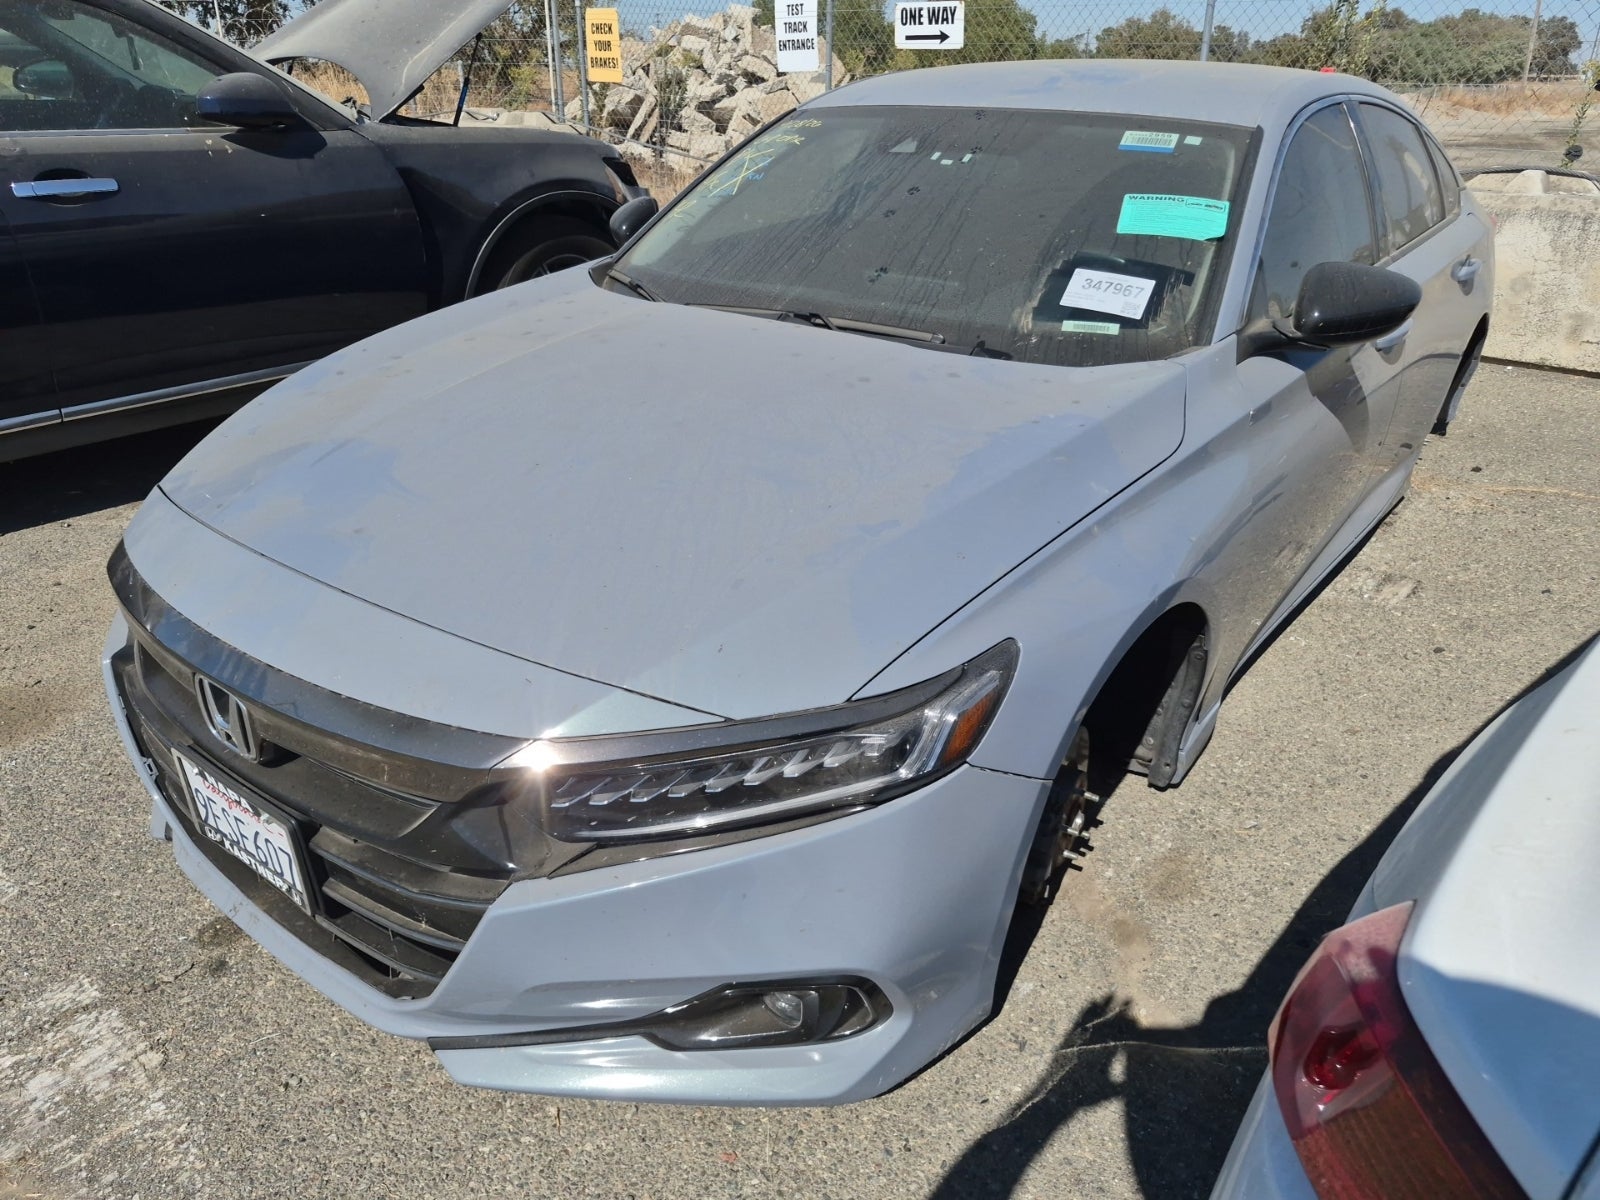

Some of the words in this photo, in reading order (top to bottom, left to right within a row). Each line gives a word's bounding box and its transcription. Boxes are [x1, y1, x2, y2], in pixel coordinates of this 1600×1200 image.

[786, 4, 804, 16] TEST
[900, 7, 924, 26] ONE
[927, 6, 957, 25] WAY
[590, 22, 613, 35] CHECK
[784, 21, 808, 34] TRACK
[593, 40, 612, 52] YOUR
[778, 38, 815, 52] ENTRANCE
[590, 57, 619, 69] BRAKES!
[1128, 195, 1185, 203] WARNING
[1081, 278, 1145, 298] 347967
[194, 787, 299, 890] 9ESE607
